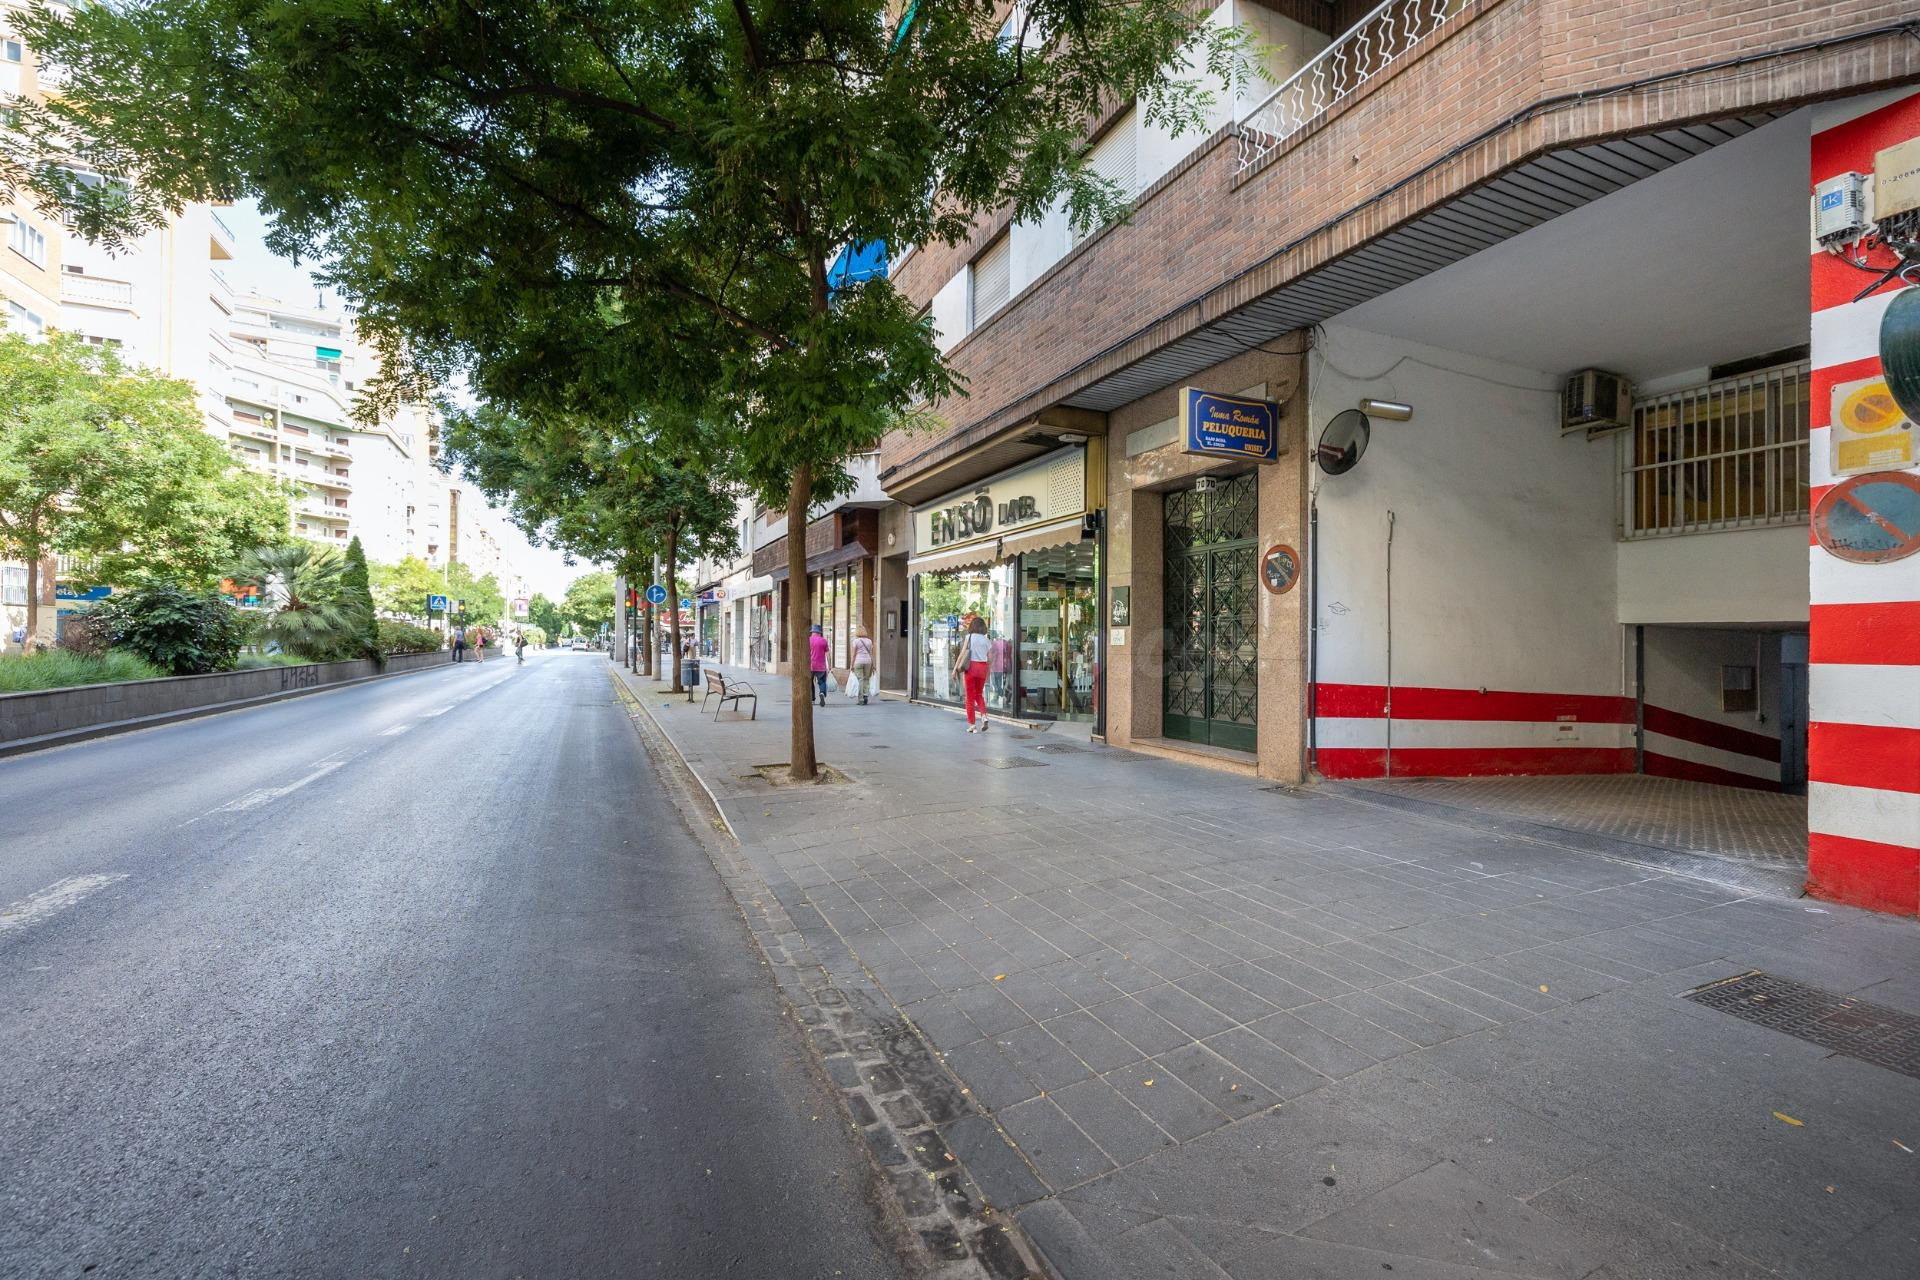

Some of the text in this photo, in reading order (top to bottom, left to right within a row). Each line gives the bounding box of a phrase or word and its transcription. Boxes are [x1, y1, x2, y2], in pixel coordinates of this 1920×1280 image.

[1209, 406, 1260, 425] Inma Román
[1202, 421, 1266, 440] PELUQUERIA
[1244, 443, 1263, 452] UNISEX
[1206, 480, 1215, 488] 70
